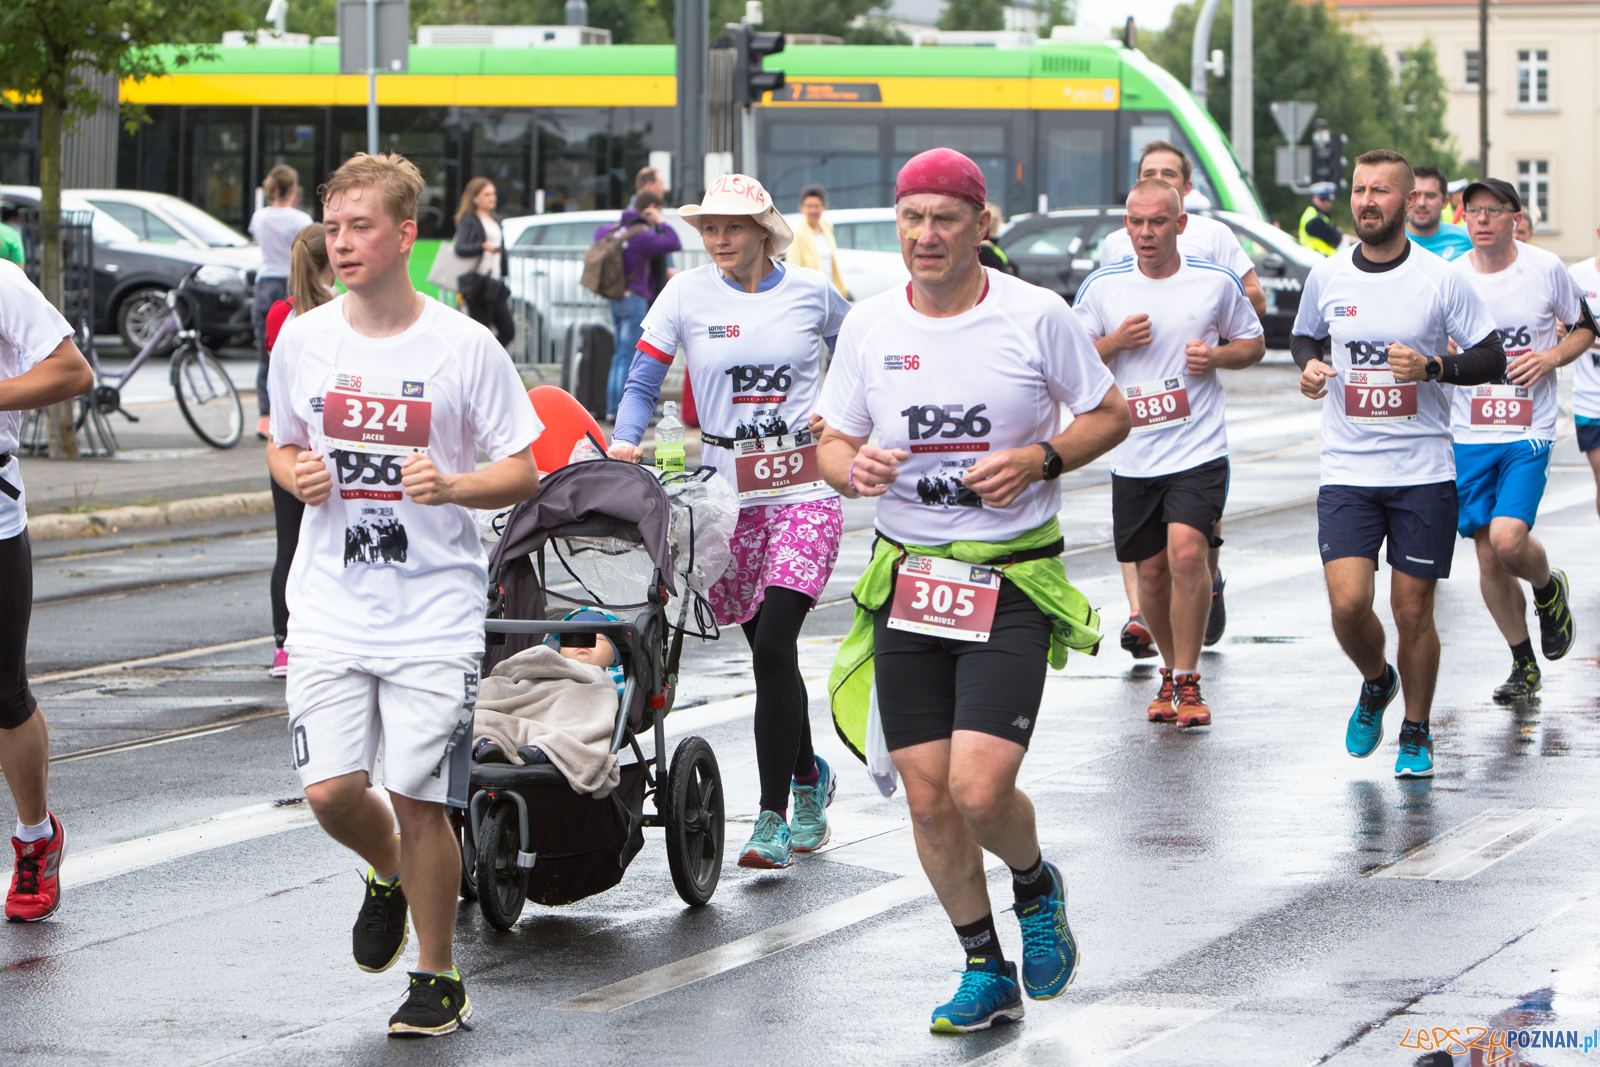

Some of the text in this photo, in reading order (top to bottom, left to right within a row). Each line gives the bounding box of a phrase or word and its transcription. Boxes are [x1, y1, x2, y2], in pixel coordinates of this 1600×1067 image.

[724, 363, 792, 393] 1956
[1135, 394, 1176, 418] 880
[1357, 388, 1403, 409] 708
[1481, 400, 1521, 418] 689
[342, 398, 408, 432] 324
[900, 403, 992, 440] 1956
[361, 432, 385, 442] JACEK
[328, 449, 404, 485] 1956
[754, 452, 804, 480] 659
[771, 479, 791, 487] BEATA
[910, 580, 976, 617] 305
[922, 614, 956, 626] MARIUSZ
